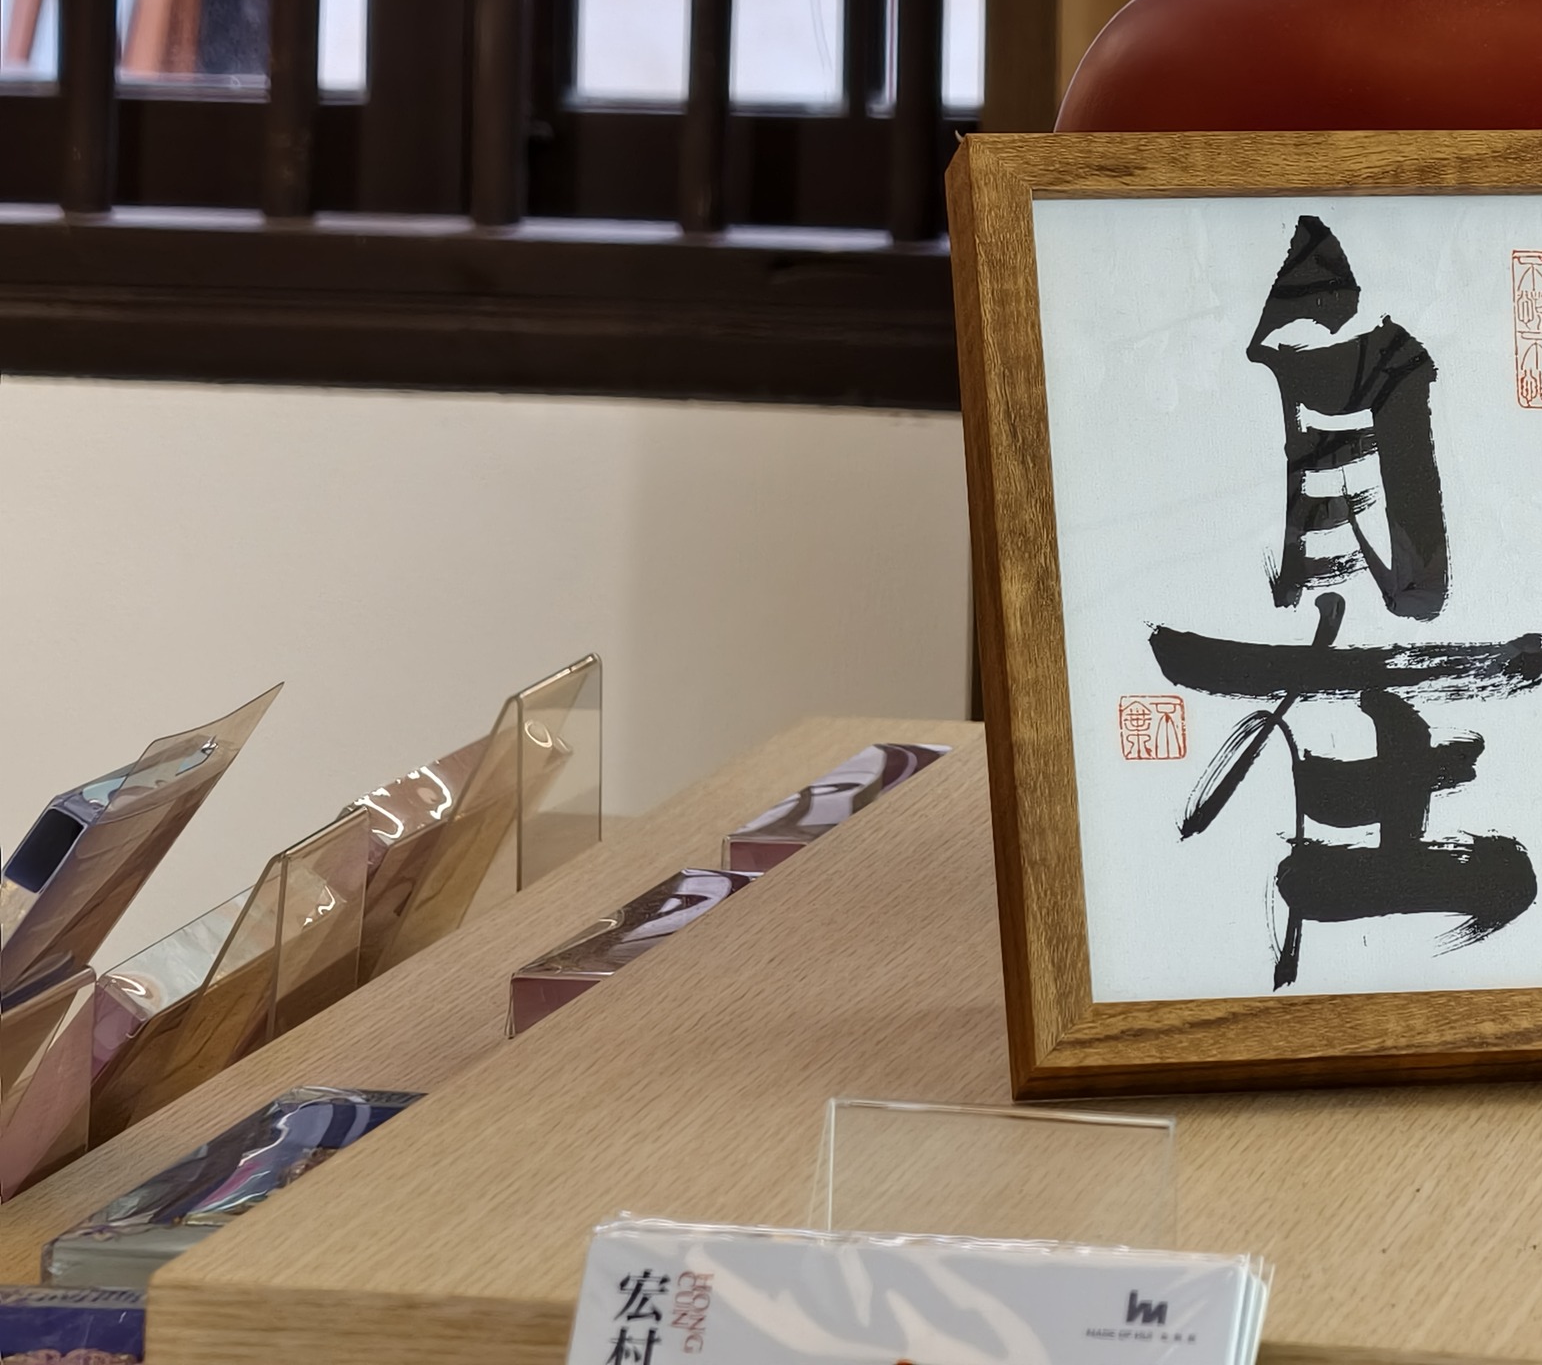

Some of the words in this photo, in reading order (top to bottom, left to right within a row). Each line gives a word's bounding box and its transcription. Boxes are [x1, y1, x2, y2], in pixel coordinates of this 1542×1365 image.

[605, 1268, 671, 1365] 宏村
[669, 1271, 697, 1331] CUN
[683, 1272, 715, 1354] HONG
